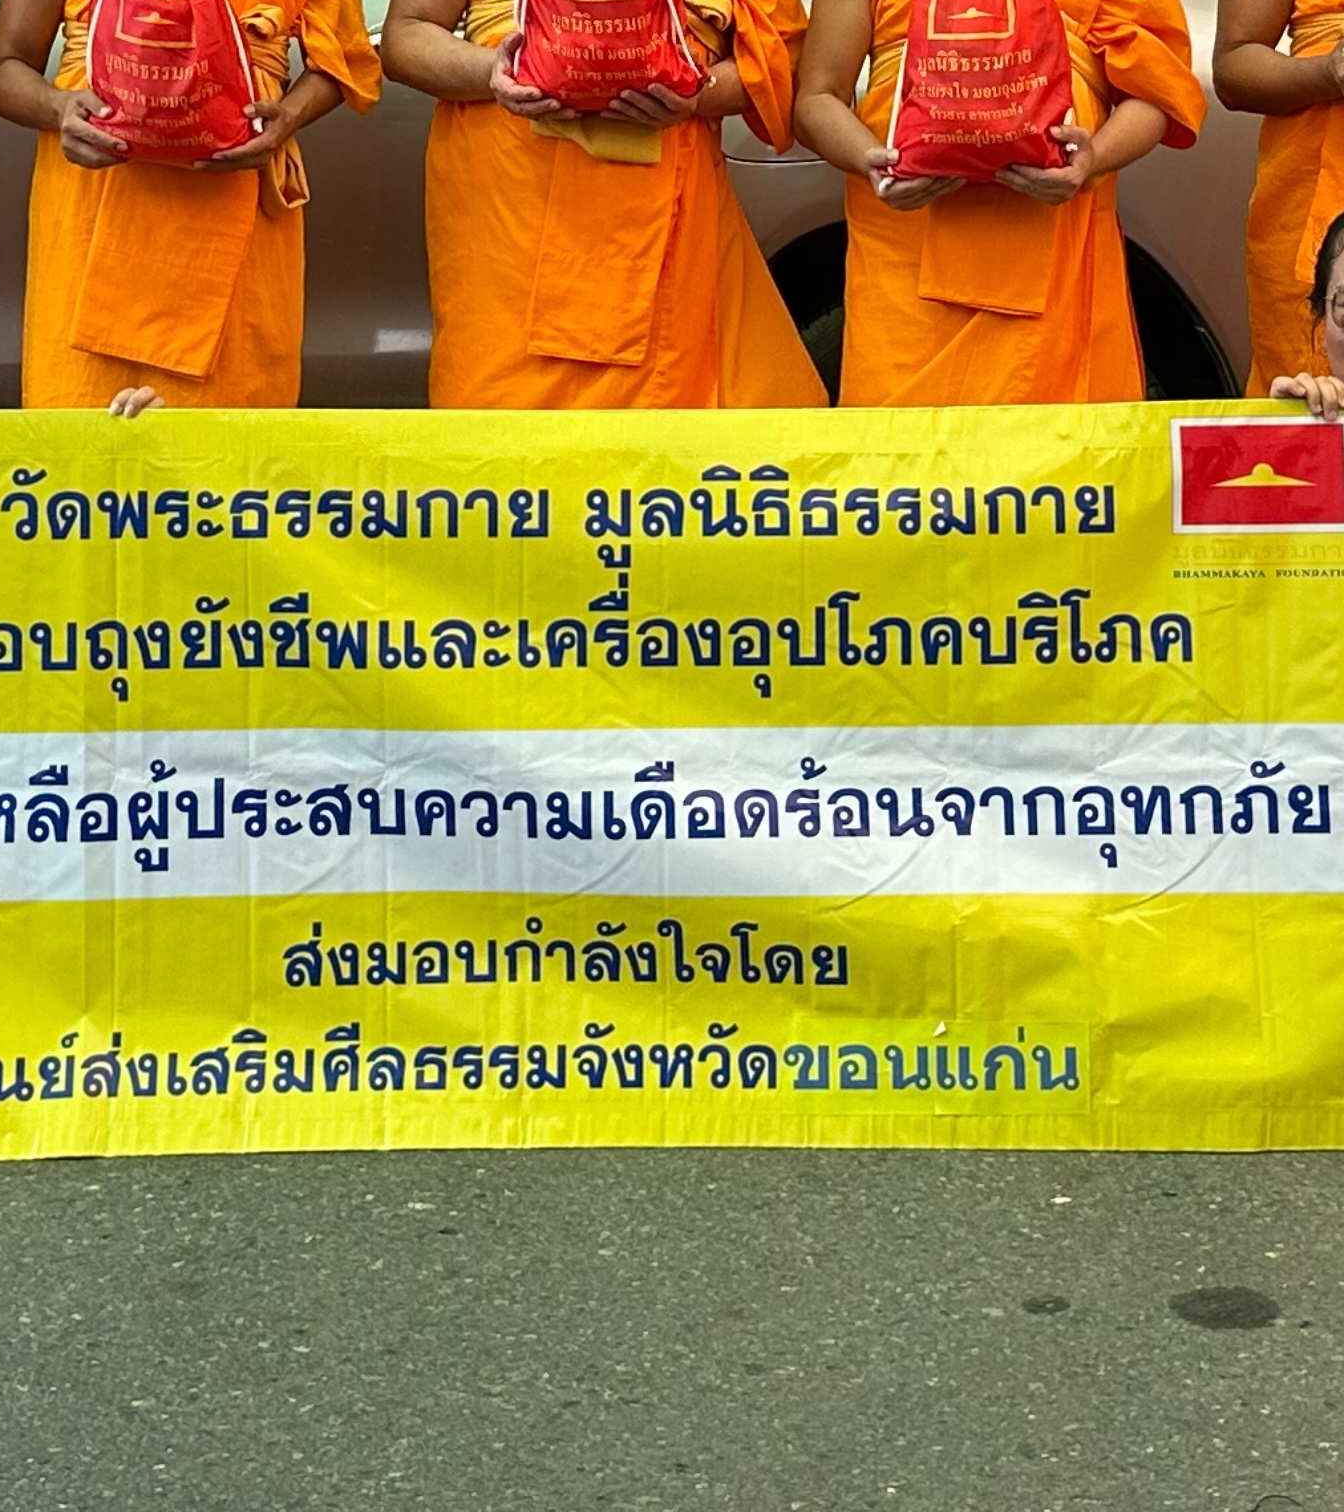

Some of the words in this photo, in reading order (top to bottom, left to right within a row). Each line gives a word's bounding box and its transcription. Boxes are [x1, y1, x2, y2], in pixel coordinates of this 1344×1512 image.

[916, 48, 1032, 77] มูลนิธิธรรมกาย
[0, 468, 549, 541] วัดพระธรรมกาย
[584, 464, 1116, 569] มูลนิธิธรรมกาย
[1172, 569, 1266, 579] DHAMMAKAYA
[282, 916, 850, 989] ส่งมอบกำลังใจโดย
